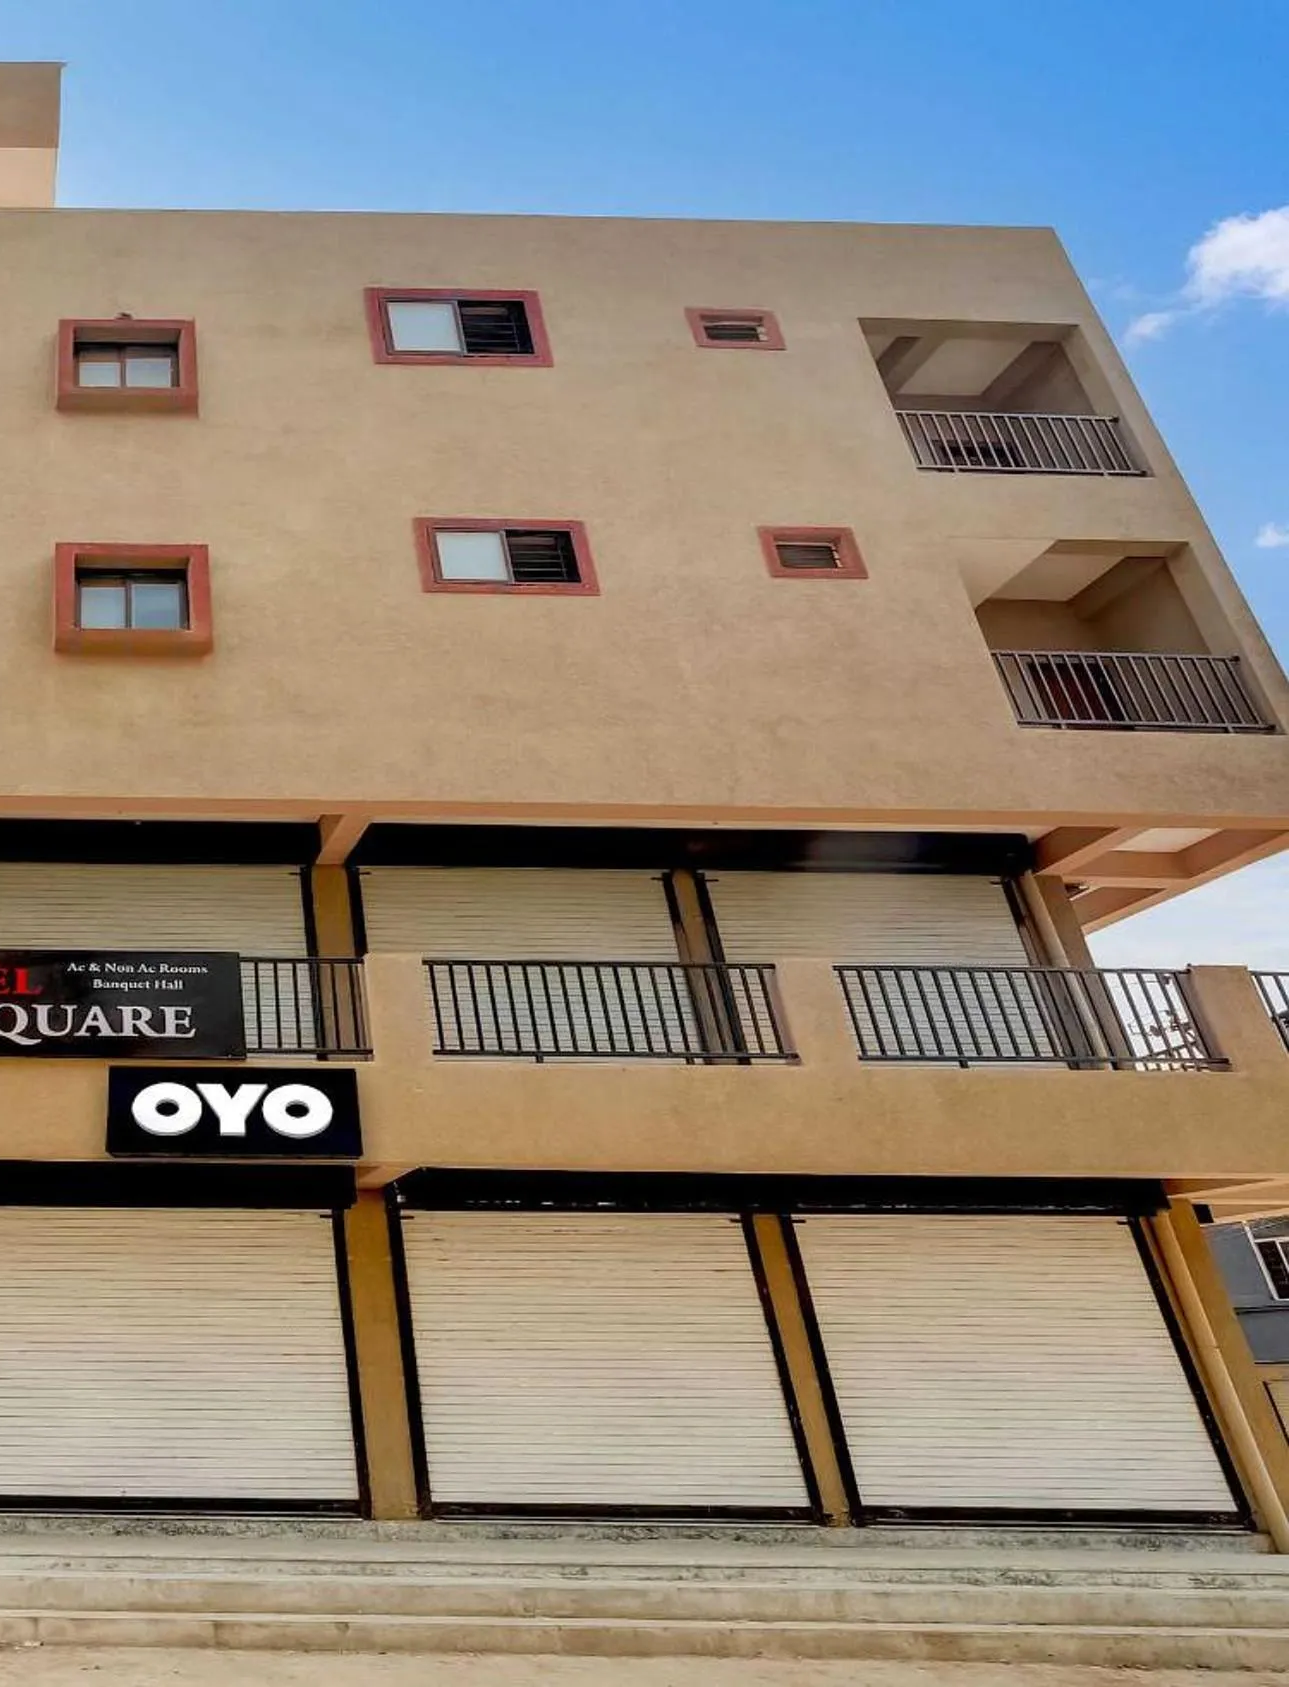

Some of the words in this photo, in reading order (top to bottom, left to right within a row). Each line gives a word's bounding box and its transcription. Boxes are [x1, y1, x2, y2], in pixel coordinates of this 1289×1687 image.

[67, 962, 86, 973] Ac
[88, 963, 101, 973] &
[104, 962, 134, 974] Non
[137, 963, 157, 974] Ac
[159, 963, 209, 974] Rooms
[92, 978, 150, 992] Banquet
[154, 979, 184, 990] Hall
[131, 1081, 334, 1138] OYO
